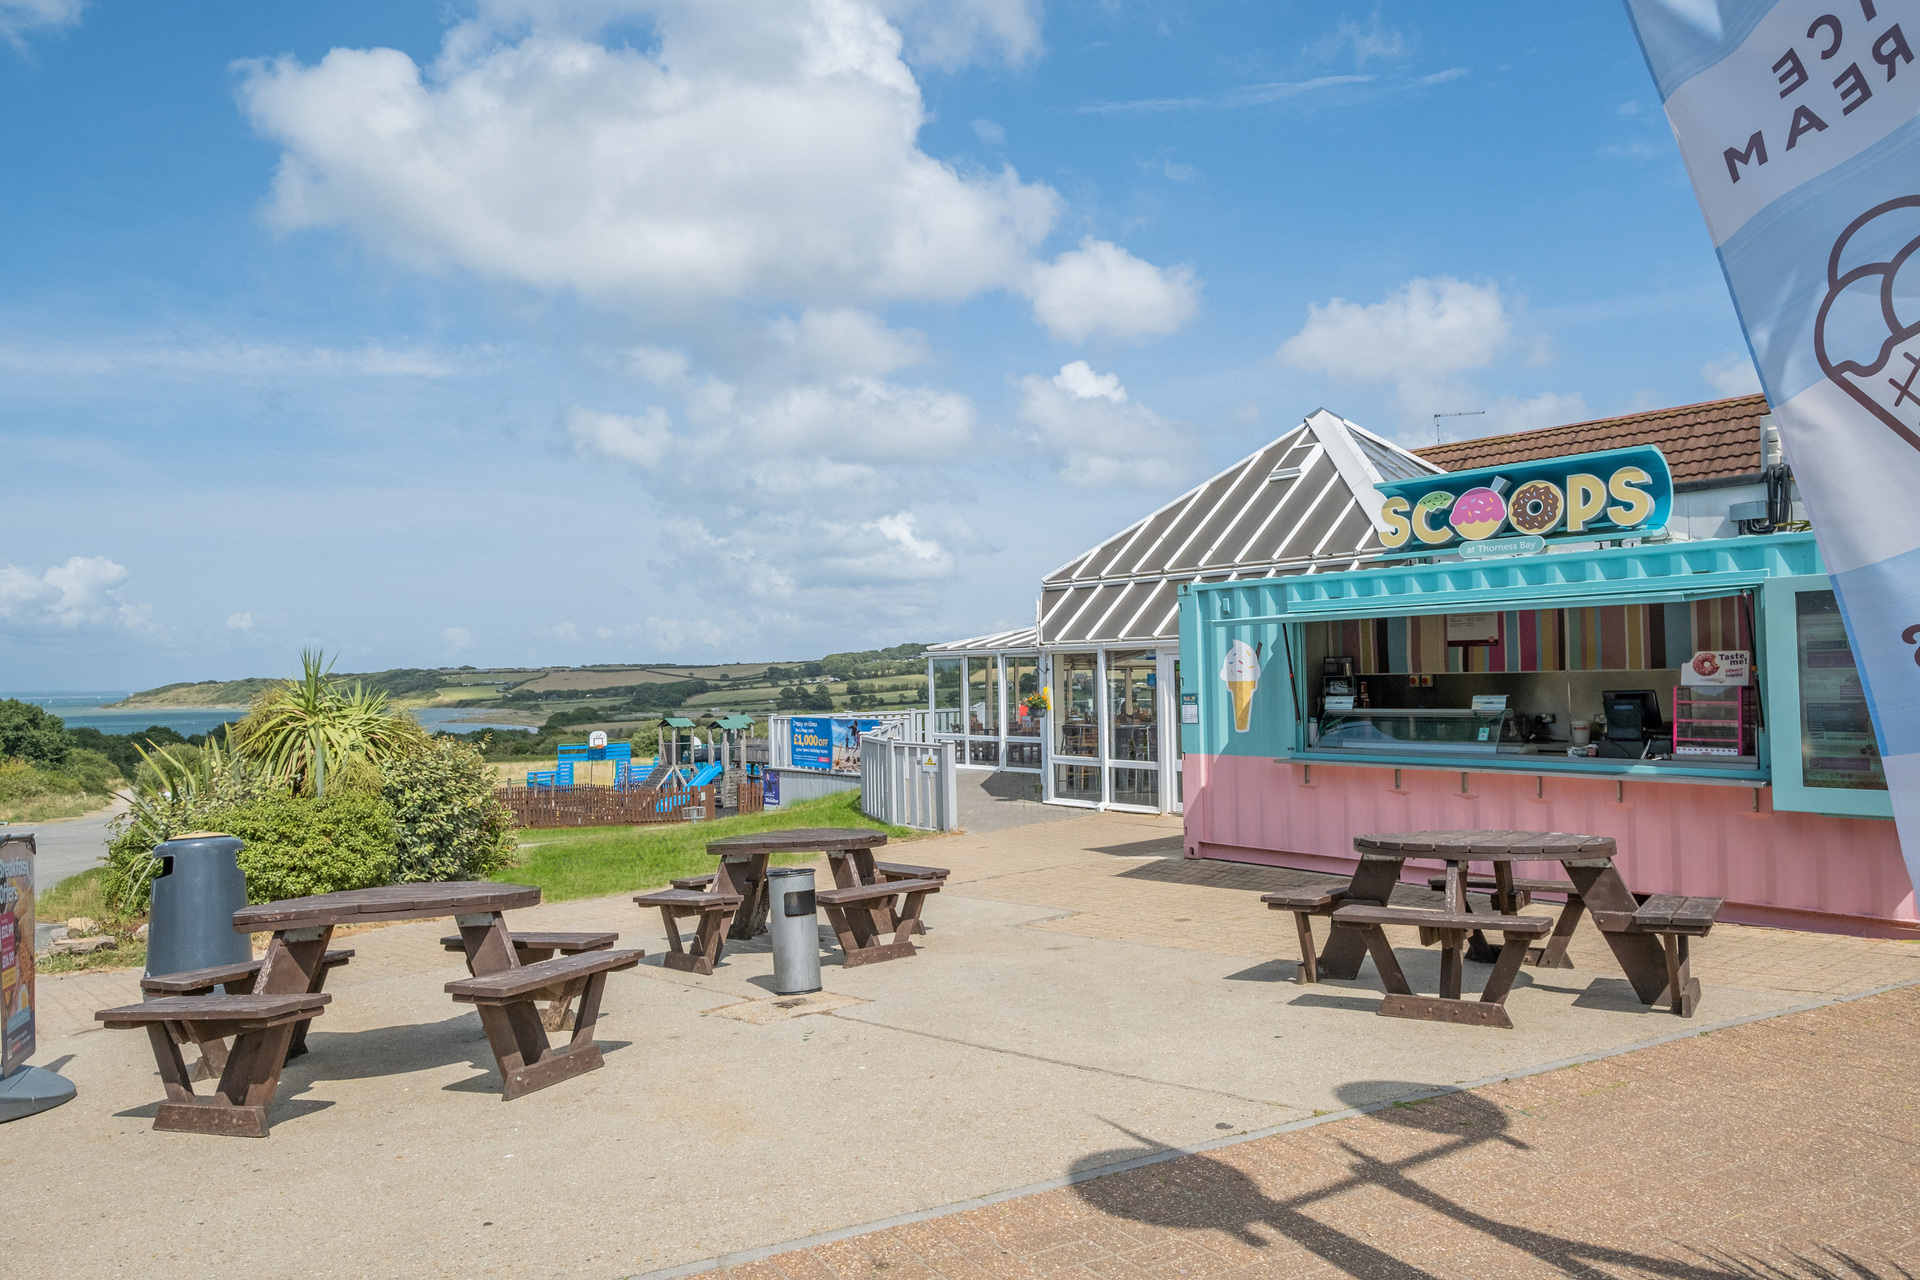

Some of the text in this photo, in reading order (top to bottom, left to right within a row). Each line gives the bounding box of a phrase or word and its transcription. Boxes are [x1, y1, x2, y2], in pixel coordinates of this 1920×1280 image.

[1378, 466, 1657, 549] SCOOPS
[1466, 541, 1537, 554] at Thorness Bay
[794, 734, 818, 747] £1,000
